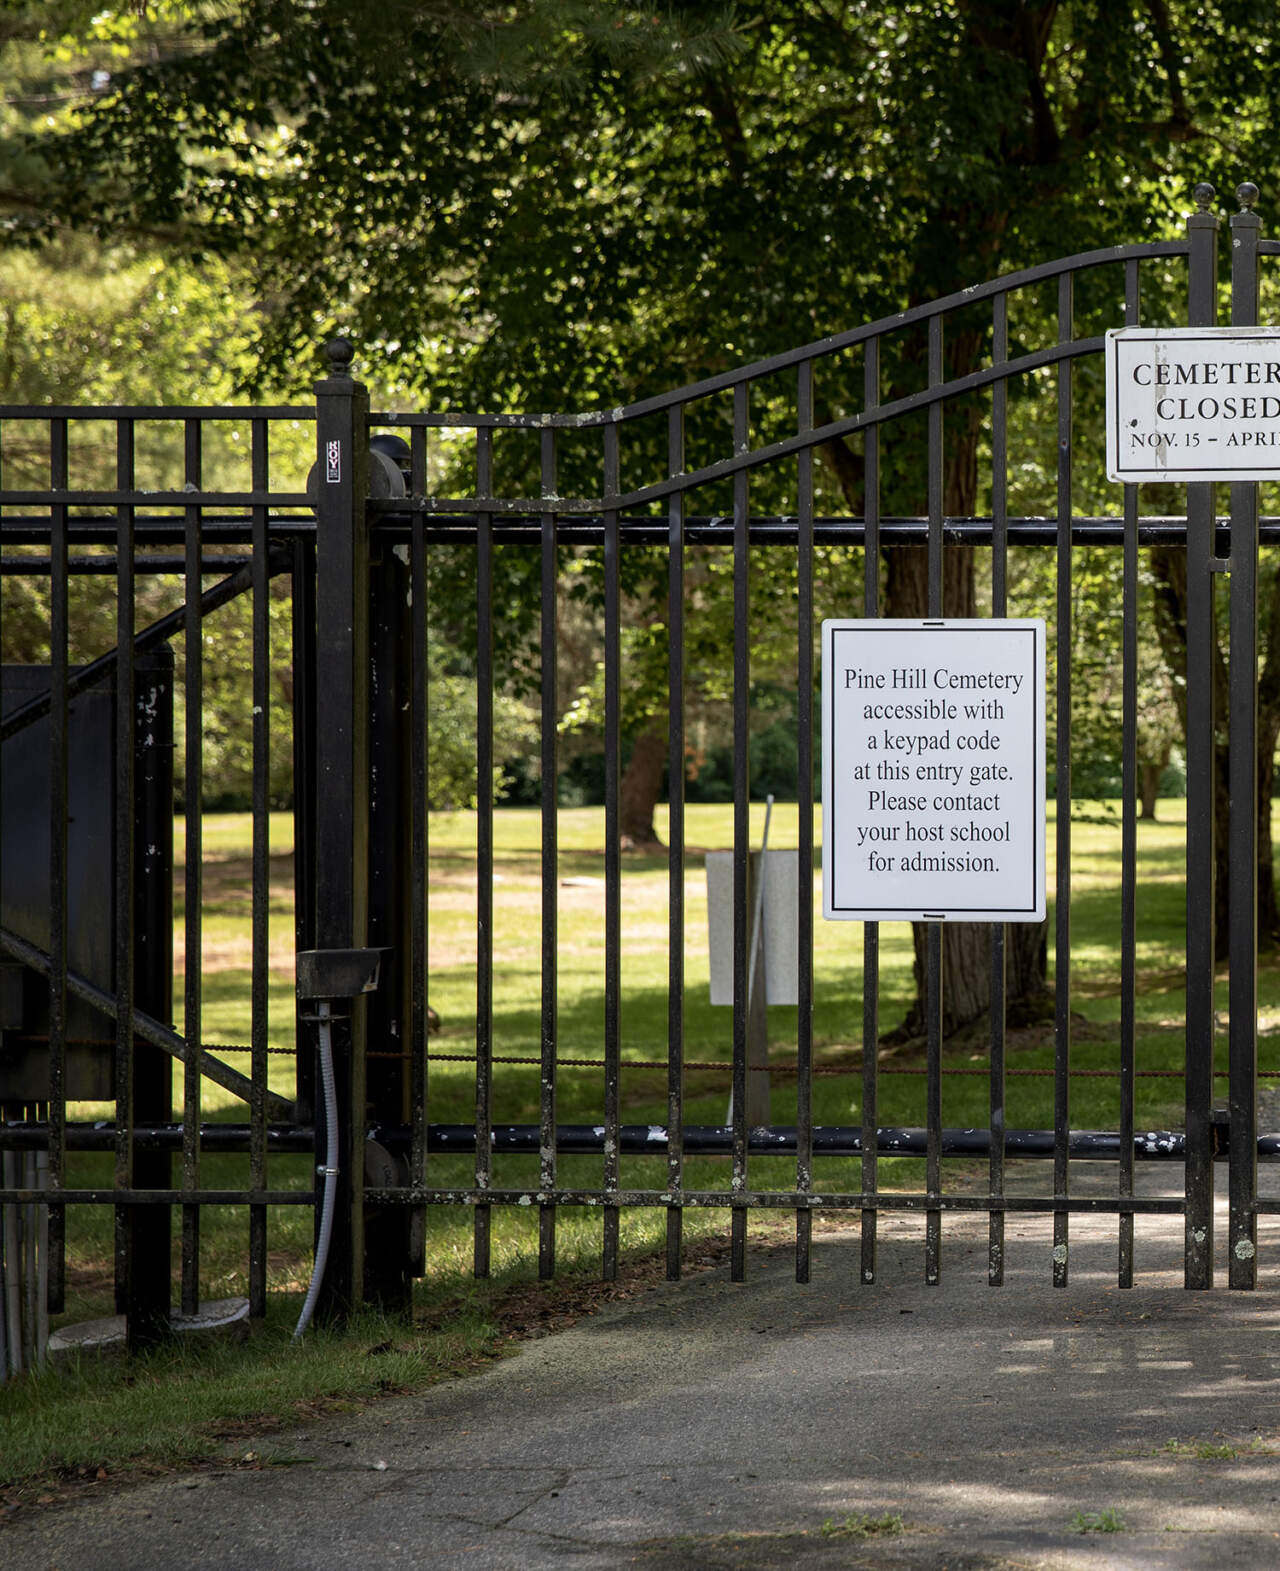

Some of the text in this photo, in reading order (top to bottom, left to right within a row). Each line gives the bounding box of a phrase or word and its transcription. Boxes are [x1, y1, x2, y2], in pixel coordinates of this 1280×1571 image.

[1131, 433, 1178, 447] NOV.
[1185, 433, 1200, 448] 15
[844, 669, 1024, 695] Pine Hill Cemetery
[863, 699, 1004, 720] accessible with
[867, 730, 1001, 756] a keypad code
[854, 760, 1013, 787] at this entry gate.
[868, 791, 1001, 811] Please contact
[857, 821, 1010, 847] your host school
[868, 851, 1000, 873] for admission.
